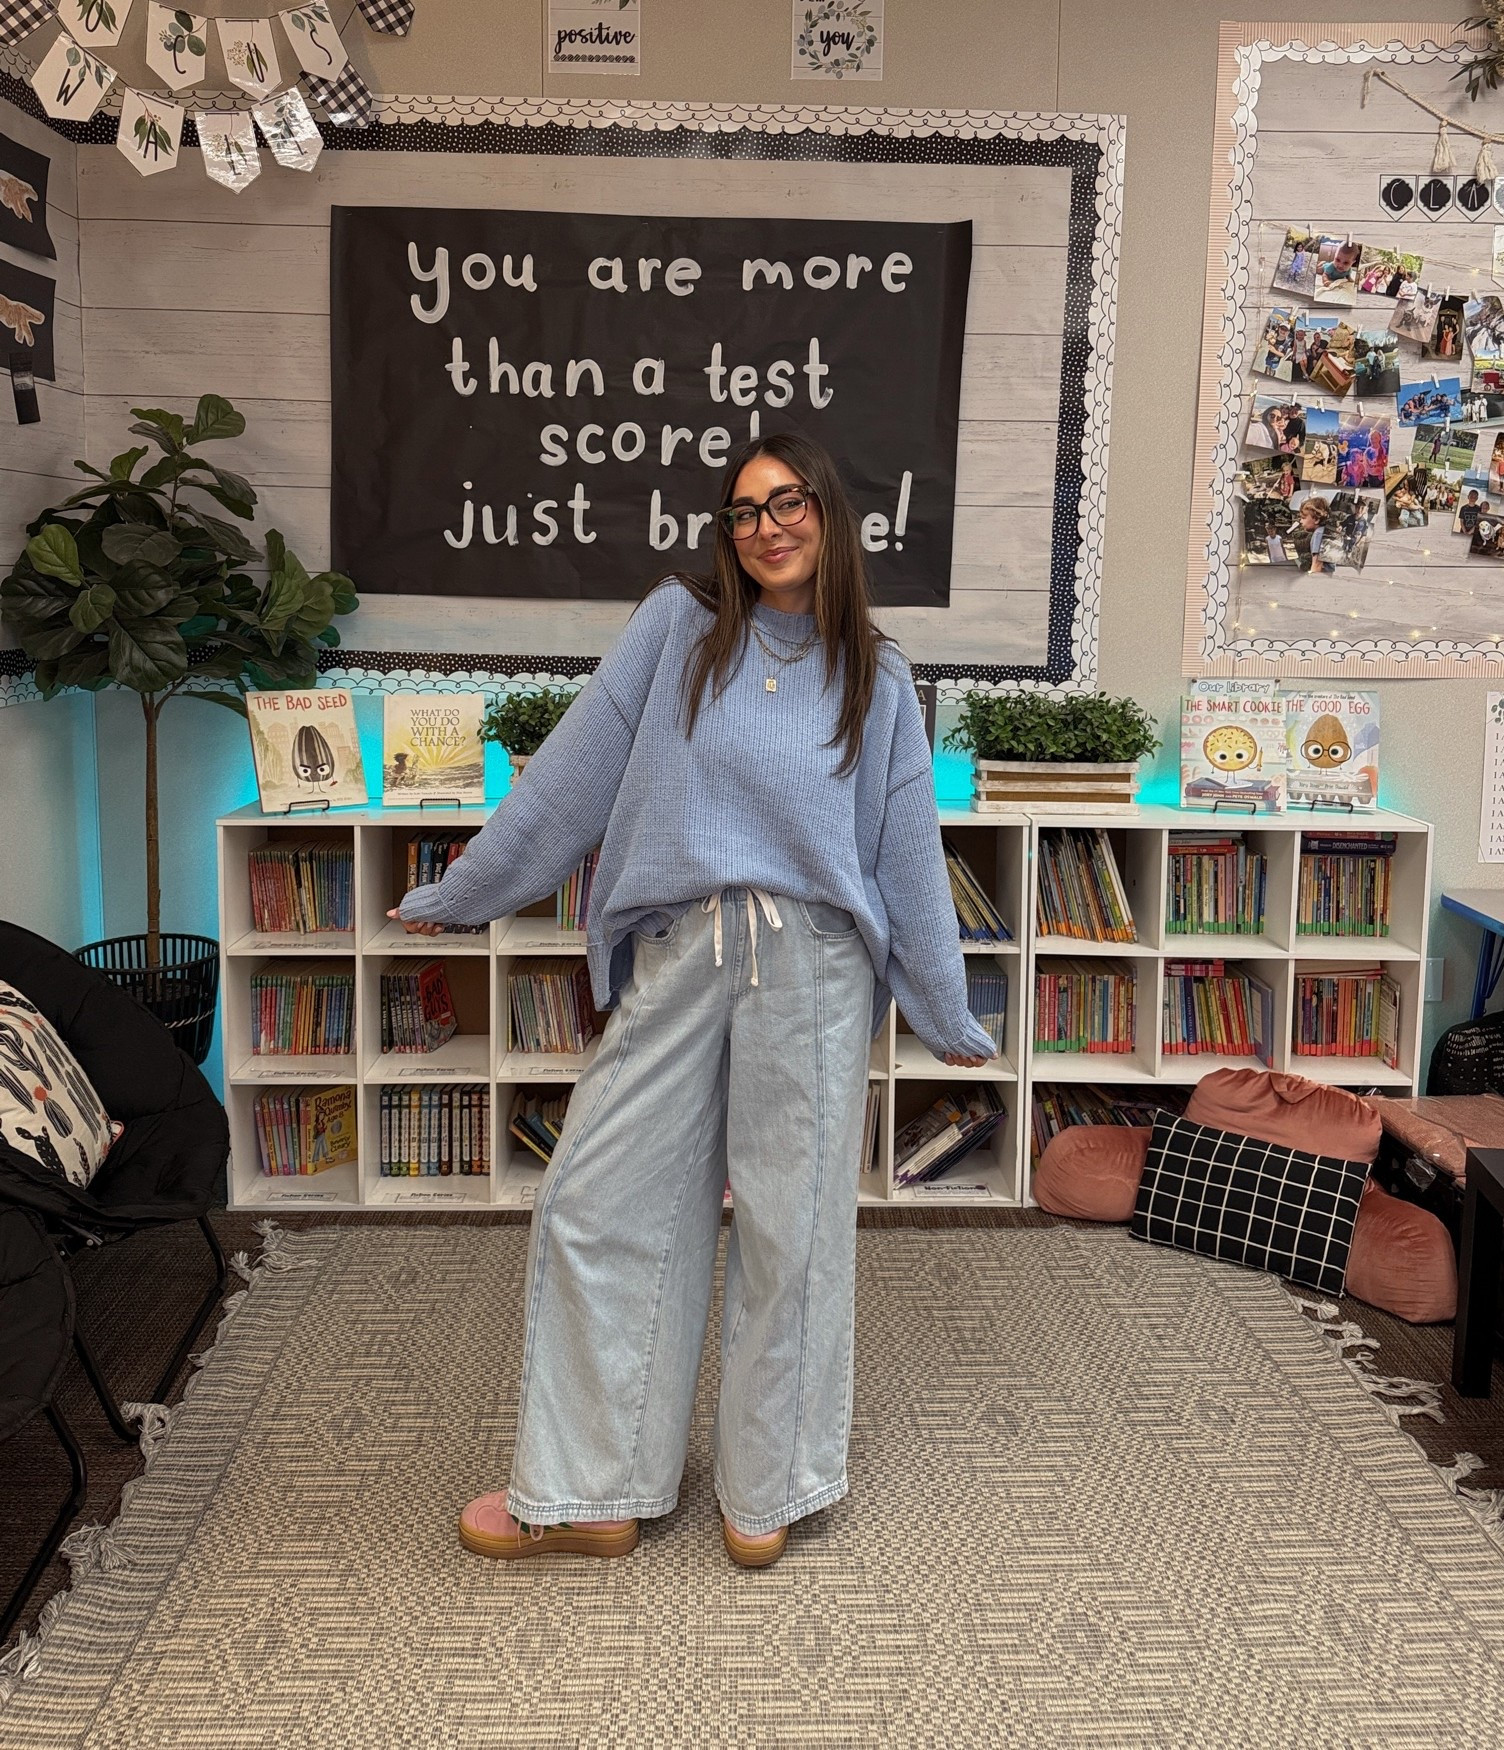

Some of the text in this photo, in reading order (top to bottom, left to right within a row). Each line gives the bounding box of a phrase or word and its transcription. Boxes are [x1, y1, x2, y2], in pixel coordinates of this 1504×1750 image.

[554, 22, 635, 55] positive
[820, 27, 855, 56] you
[407, 241, 913, 324] you are more
[445, 336, 834, 410] than a test
[444, 481, 597, 550] just
[1198, 681, 1223, 692] Our
[253, 693, 347, 712] THE BAD SEED
[1185, 699, 1281, 713] THE SMART COOKIE
[1286, 700, 1370, 714] THE GOOD EGG
[410, 709, 441, 717] WHAT
[410, 717, 460, 726] YOU DO
[411, 726, 459, 736] WITH A
[410, 736, 466, 747] CHANCE?
[1332, 842, 1367, 850] DISENCHANTED
[315, 1090, 351, 1111] Ramona
